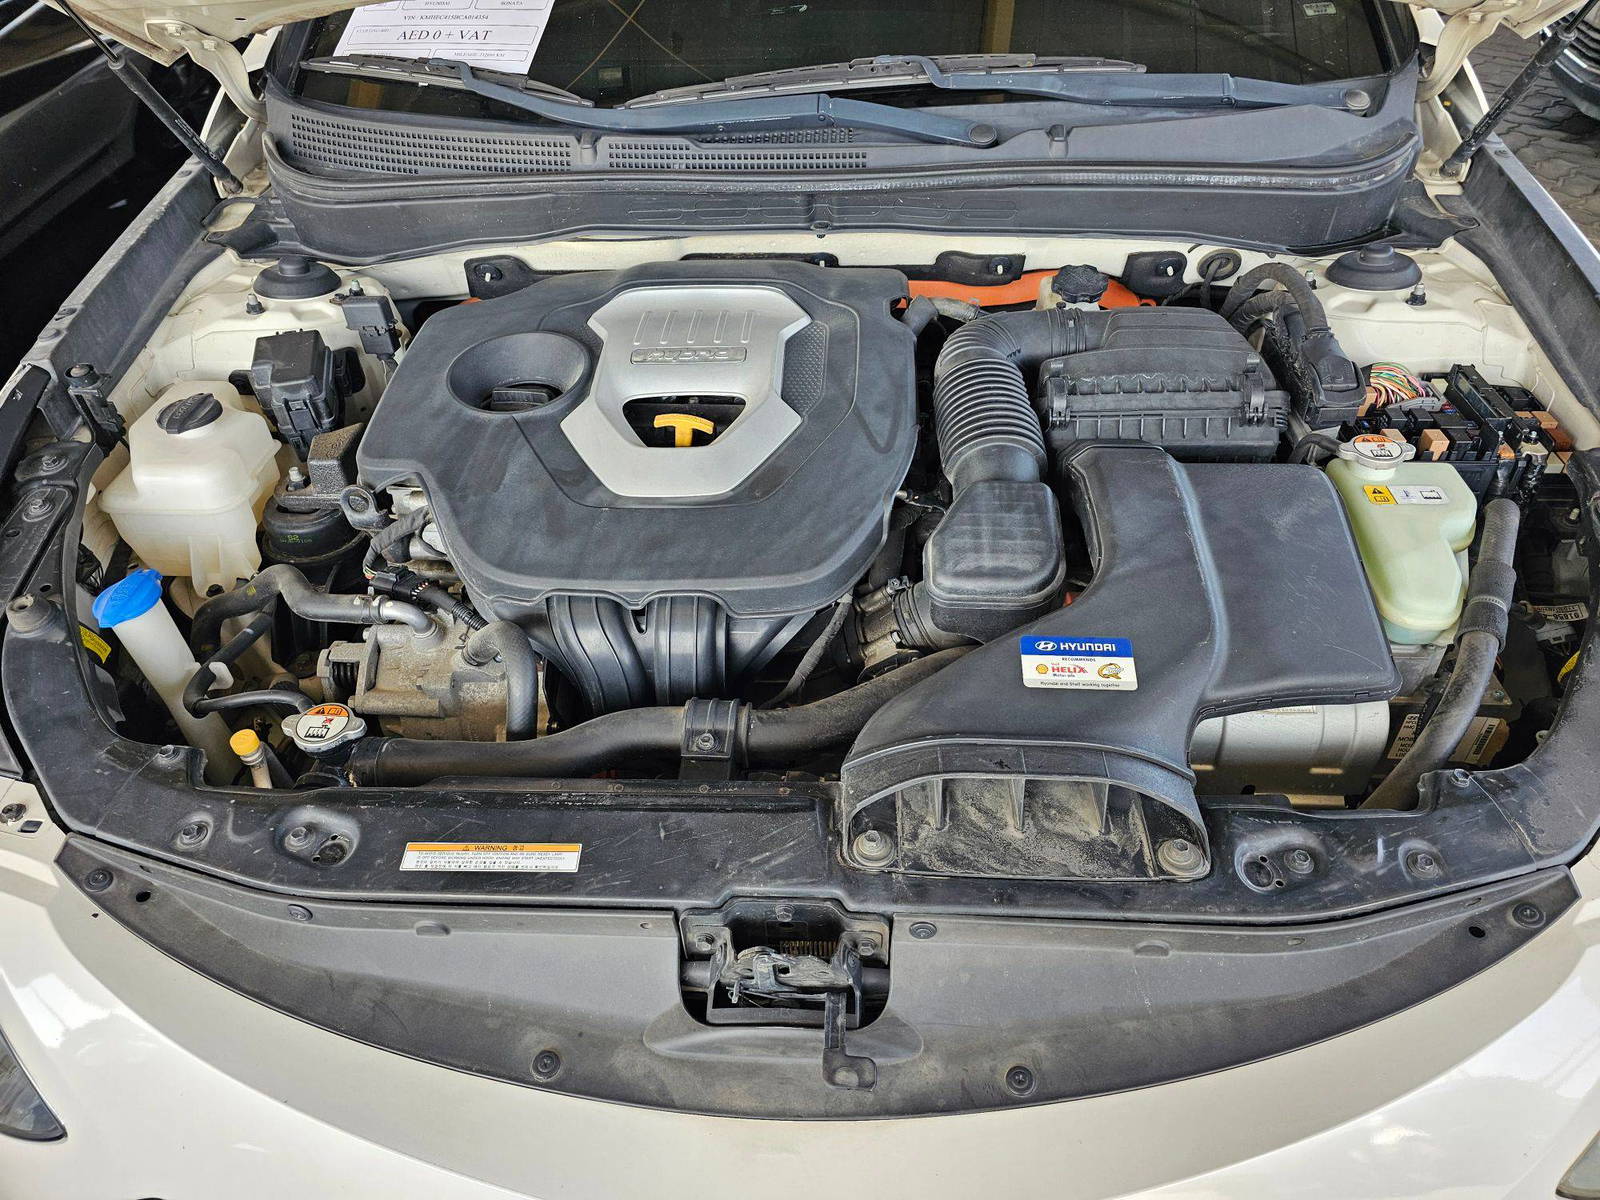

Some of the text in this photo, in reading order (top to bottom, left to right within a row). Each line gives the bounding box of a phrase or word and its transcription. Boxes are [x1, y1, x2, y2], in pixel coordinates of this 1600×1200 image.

[397, 30, 493, 40] AED 0 + VAT
[1060, 642, 1116, 652] HYUNDAI
